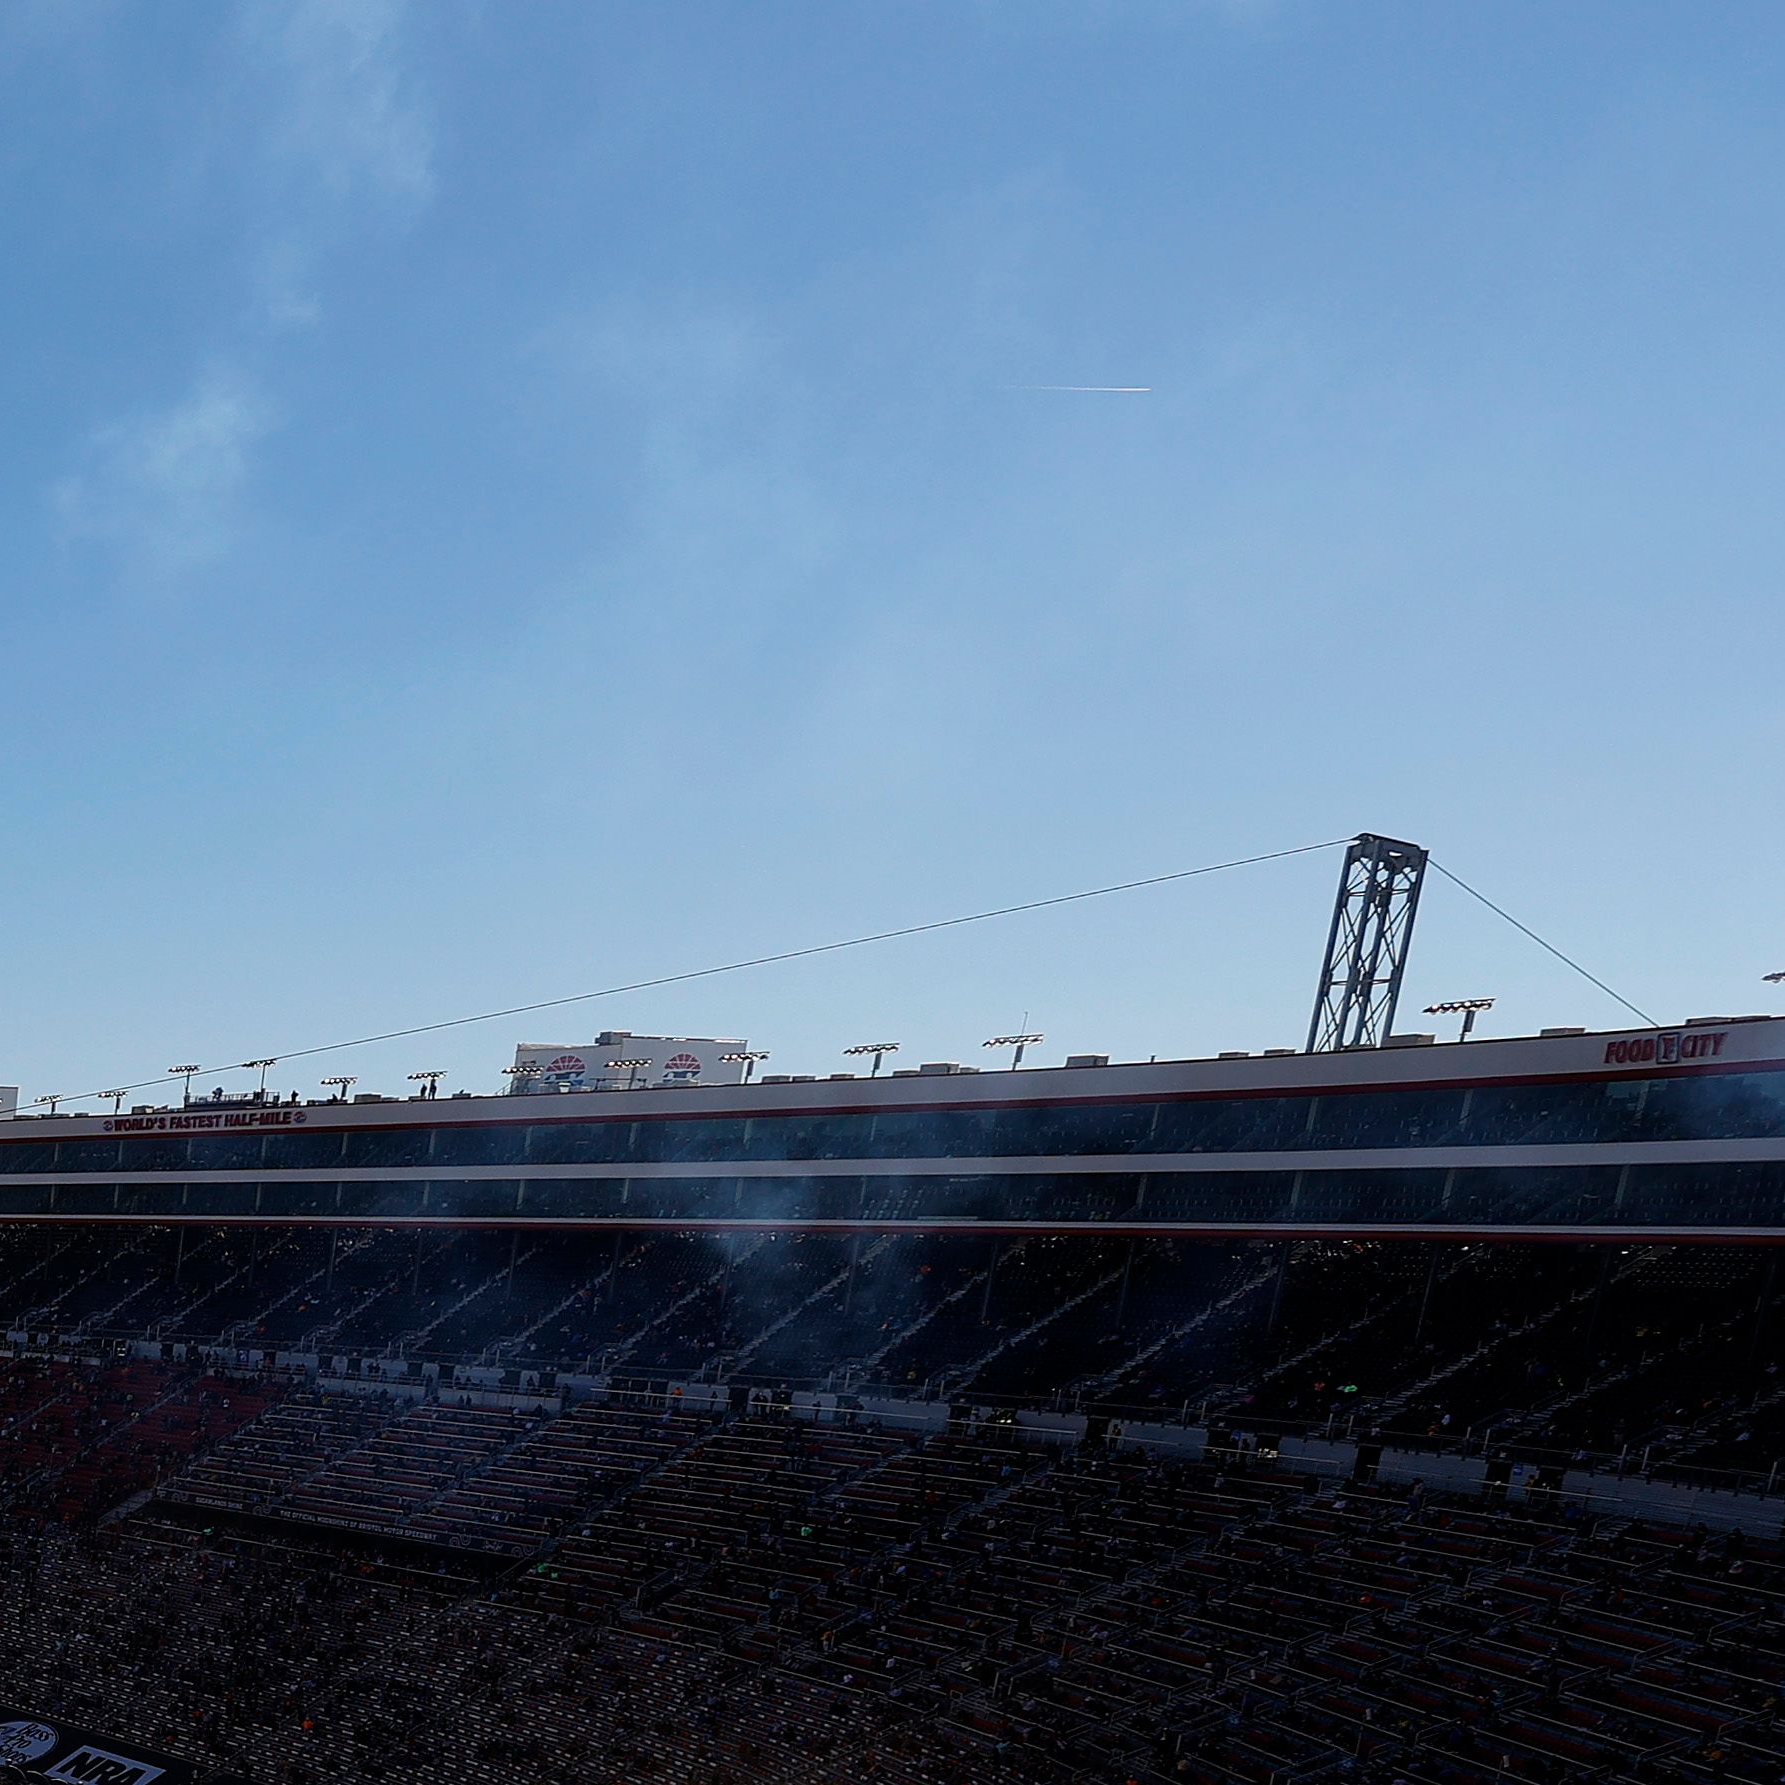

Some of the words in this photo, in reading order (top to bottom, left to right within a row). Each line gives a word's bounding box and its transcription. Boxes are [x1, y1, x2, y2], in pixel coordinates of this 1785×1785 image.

[1604, 1039, 1656, 1063] FOOD
[1681, 1032, 1728, 1058] CITY
[114, 1116, 166, 1131] WORLD'S
[170, 1113, 223, 1129] FASTEST
[224, 1111, 292, 1127] HALF-MILE
[23, 1722, 55, 1742] Bass
